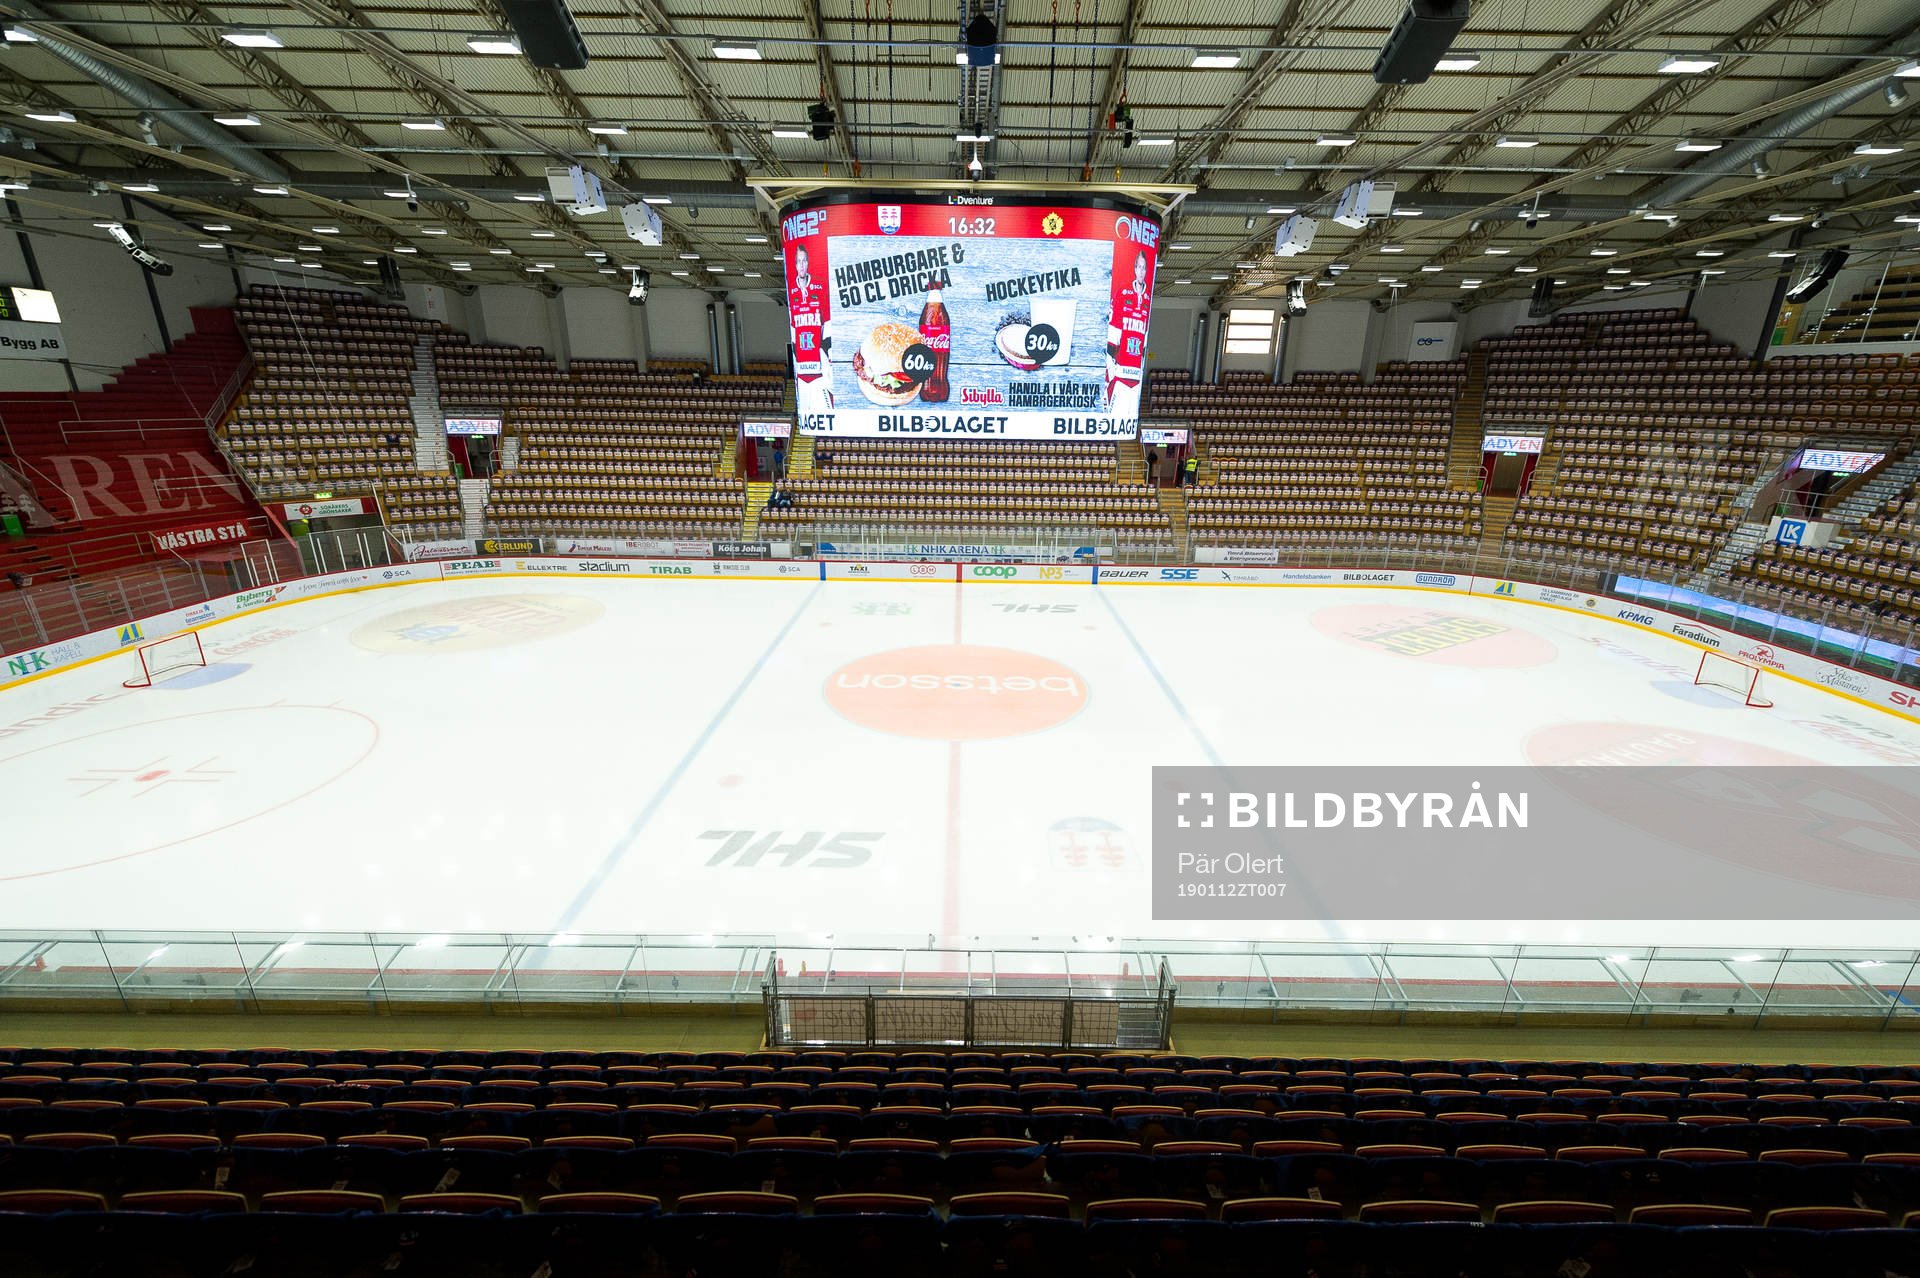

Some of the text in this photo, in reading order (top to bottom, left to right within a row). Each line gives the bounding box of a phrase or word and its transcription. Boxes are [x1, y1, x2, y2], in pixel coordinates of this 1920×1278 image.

[948, 217, 995, 235] 16:32
[835, 243, 965, 289] HAMBURGARE &
[839, 268, 952, 308] 50 CL DRICKA
[986, 267, 1081, 302] HOCKEYFIKA
[1, 337, 59, 350] Bygg AB
[1009, 380, 1100, 396] HANDLA I VÅR NYA
[962, 387, 1004, 407] Sibylla
[1009, 395, 1097, 408] HAMBRGERKIOSK
[878, 415, 1008, 433] BILBOLAGET
[1484, 437, 1541, 450] ADVEN
[718, 544, 739, 552] Köks
[741, 544, 767, 553] Johan
[921, 545, 989, 554] NHK ARENA
[451, 560, 495, 571] PEAB
[579, 561, 631, 572] stadium
[650, 566, 692, 575] TIRAB
[973, 565, 1018, 579] coop
[1039, 567, 1063, 580] NP3
[1160, 568, 1200, 580] SSE
[1343, 573, 1395, 582] BILBOLAGET
[1617, 609, 1655, 626] KPMG
[1672, 624, 1721, 648] Faradium
[8, 650, 51, 676] NHK
[836, 673, 1079, 697] betsson
